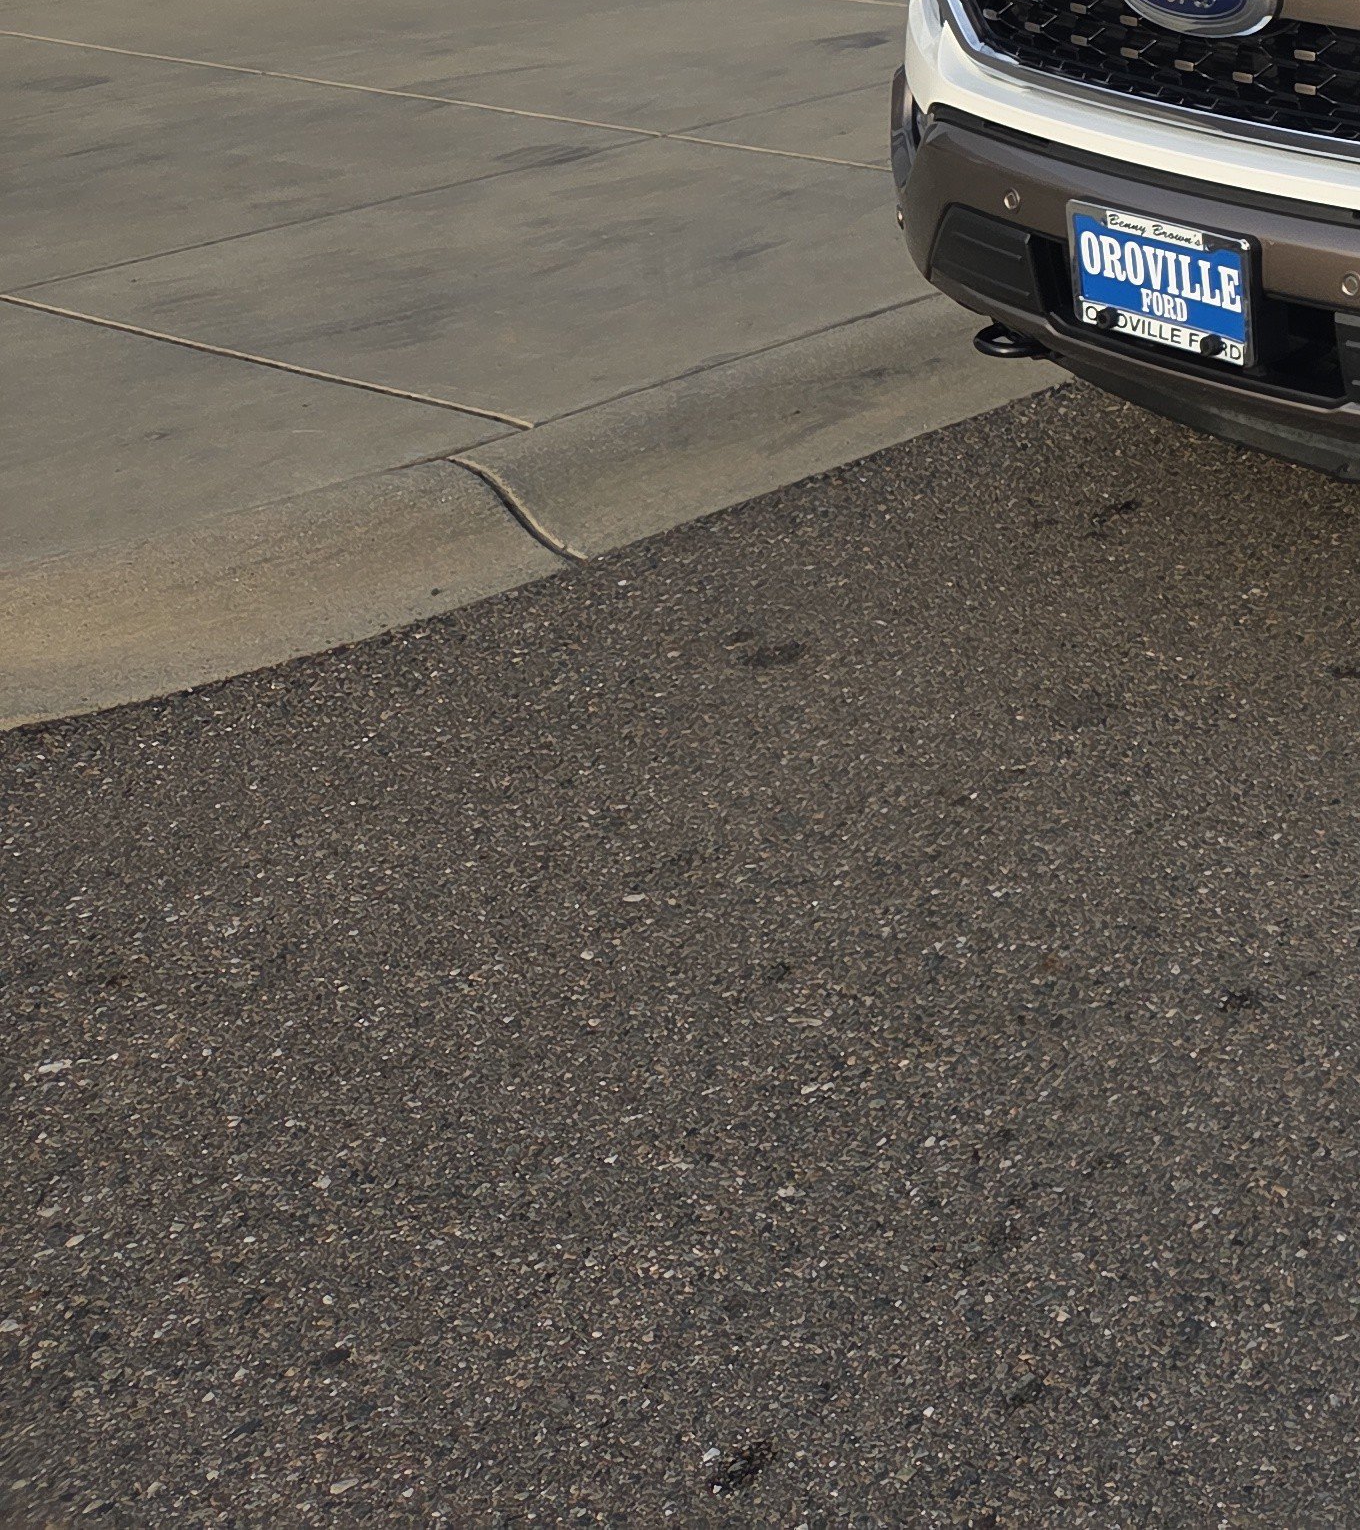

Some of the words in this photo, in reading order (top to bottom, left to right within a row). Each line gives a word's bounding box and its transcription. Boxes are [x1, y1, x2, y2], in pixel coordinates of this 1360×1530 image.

[1108, 213, 1148, 237] Benny
[1151, 223, 1202, 247] Brown's
[1080, 230, 1242, 313] OROVILLE
[1140, 288, 1188, 322] FORD
[1085, 305, 1182, 344] OOVILLE
[1189, 332, 1242, 361] FRD
